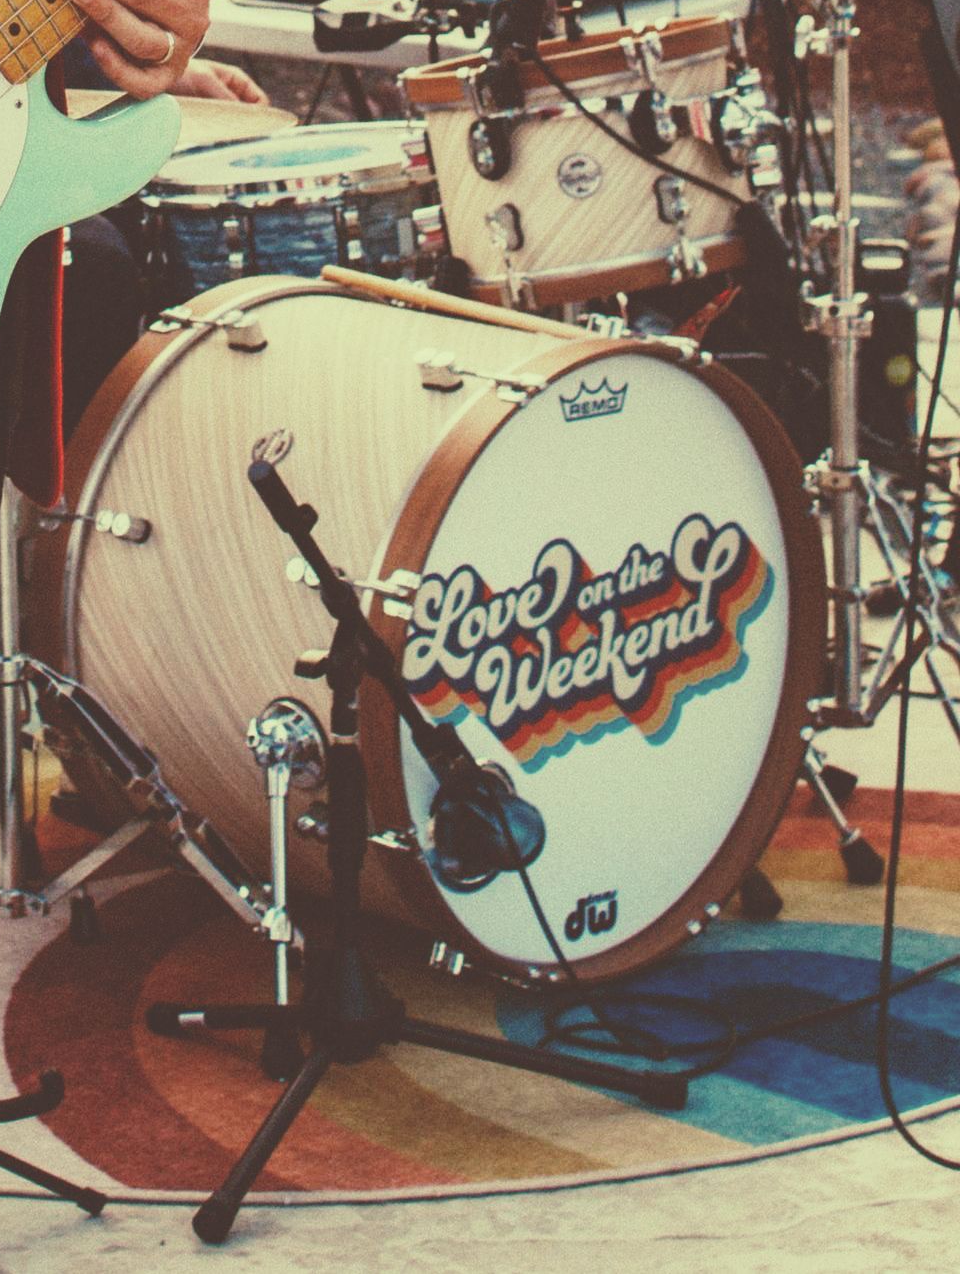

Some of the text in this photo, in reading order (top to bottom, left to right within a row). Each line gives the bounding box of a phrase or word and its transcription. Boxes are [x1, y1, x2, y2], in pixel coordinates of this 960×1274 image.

[570, 396, 619, 415] REMO
[401, 538, 664, 681] Love on the
[474, 515, 741, 727] Weekend
